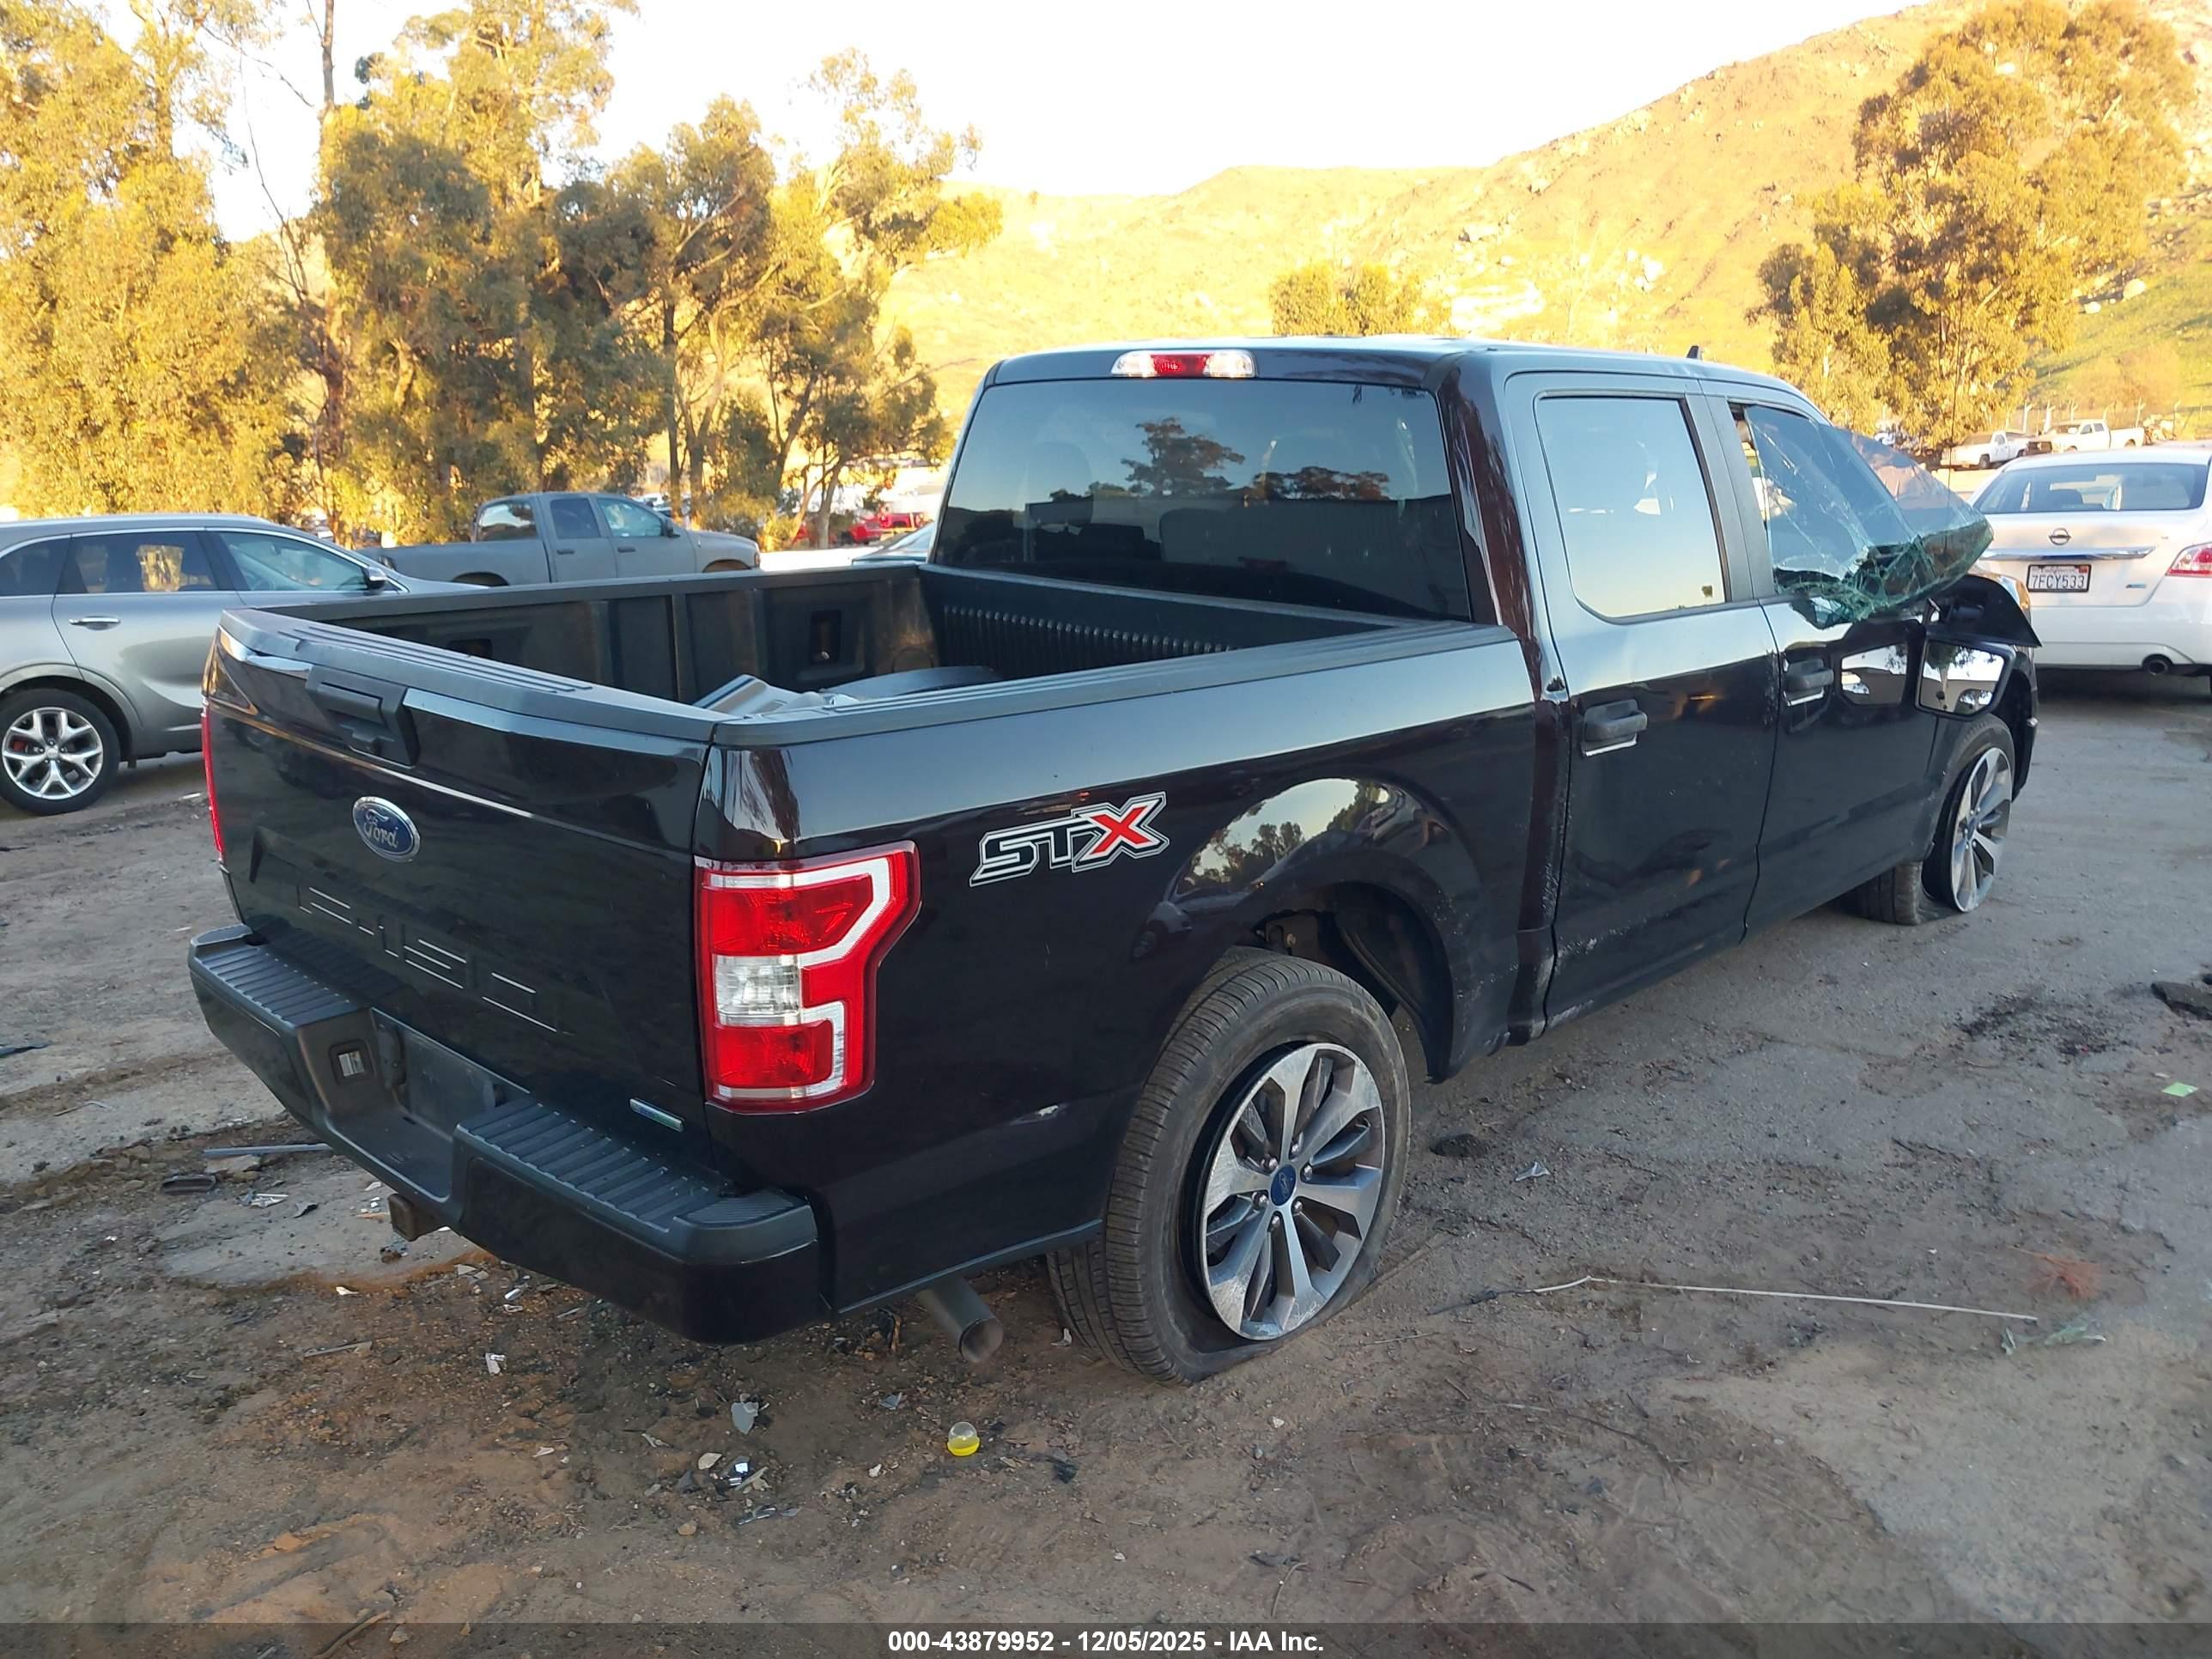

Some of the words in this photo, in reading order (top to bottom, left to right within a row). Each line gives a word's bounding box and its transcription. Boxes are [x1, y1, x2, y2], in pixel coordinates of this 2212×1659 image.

[2032, 574, 2085, 589] 7FCY533
[363, 808, 399, 848] Ford
[969, 791, 1170, 887] STX
